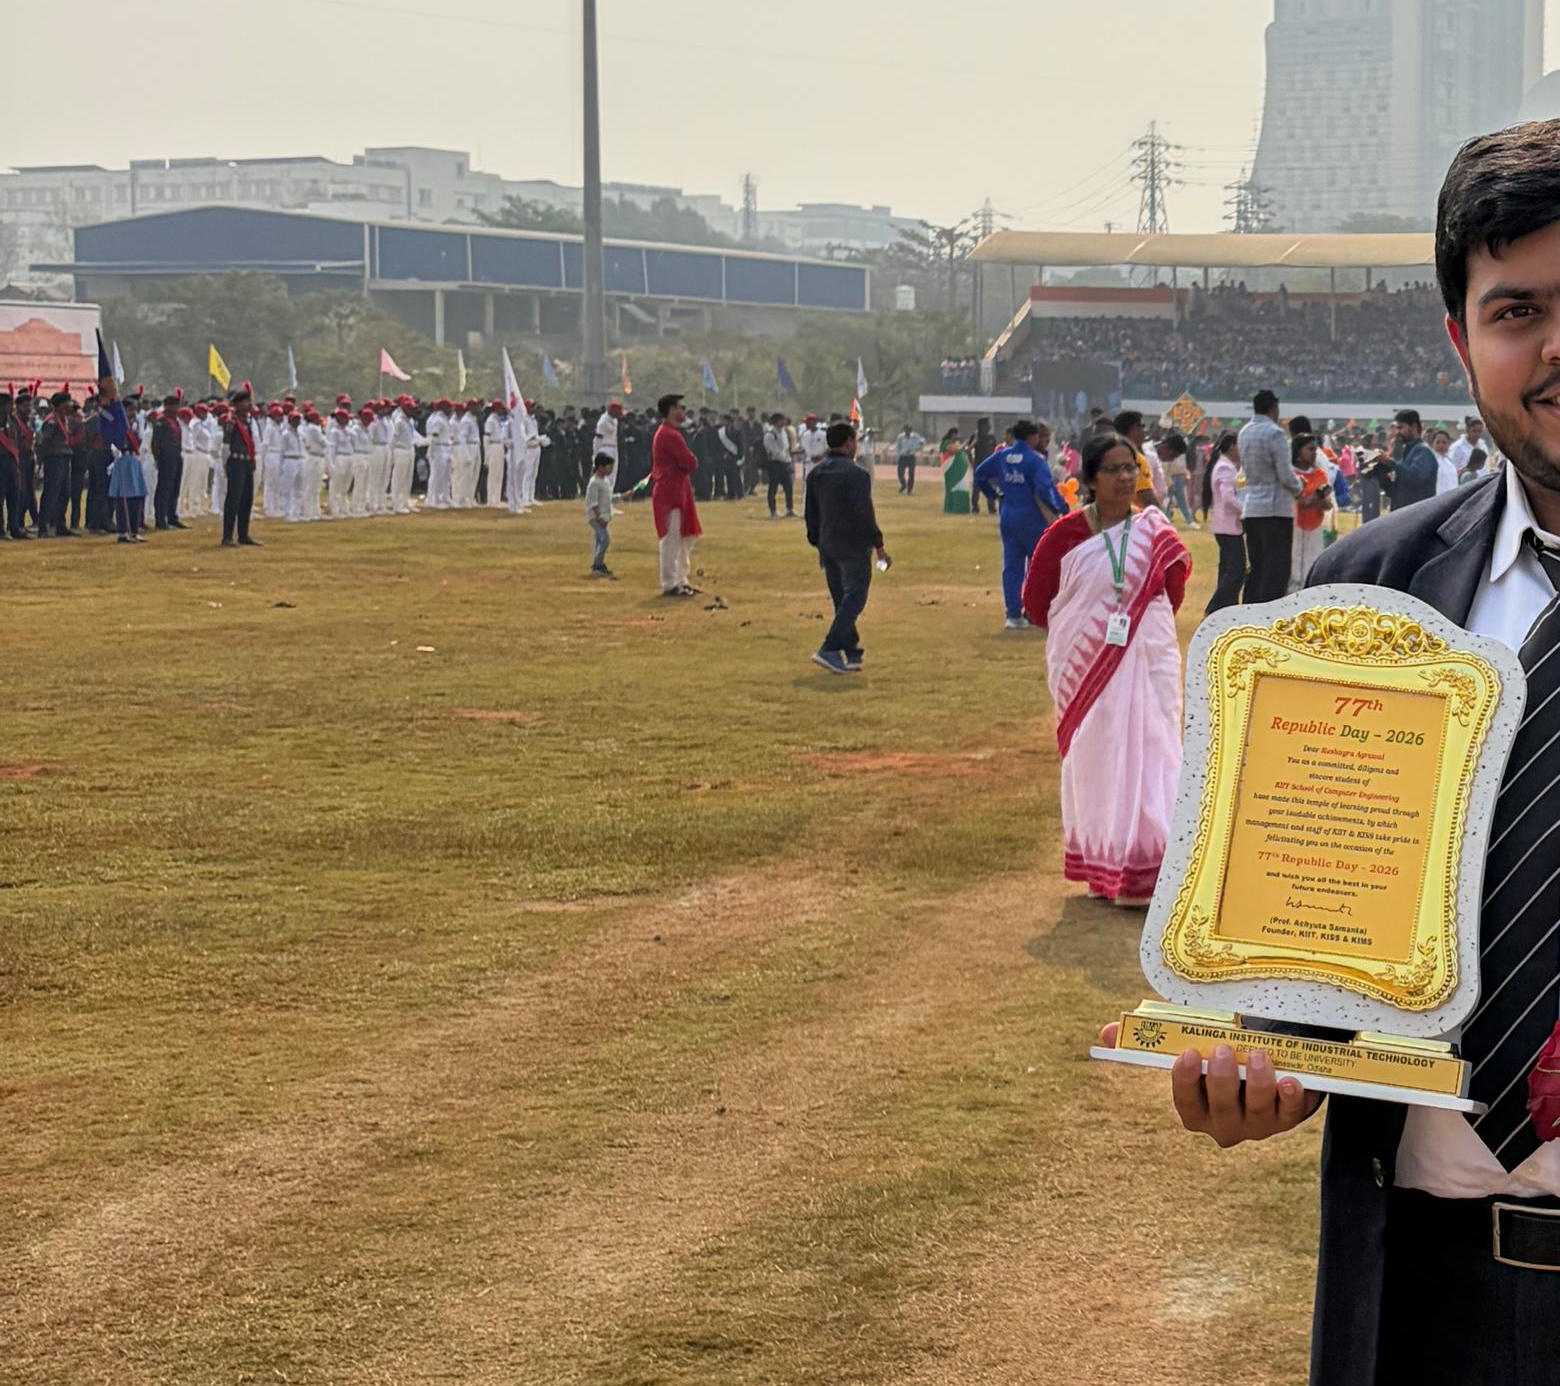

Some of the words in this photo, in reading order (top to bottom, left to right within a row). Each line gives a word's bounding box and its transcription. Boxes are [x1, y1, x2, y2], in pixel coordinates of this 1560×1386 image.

[1334, 696, 1383, 717] 77th
[1270, 716, 1336, 736] Republic
[1340, 724, 1370, 743] Day
[1385, 729, 1425, 746] 2026
[1303, 745, 1319, 753] Dear
[1308, 772, 1334, 781] sincere
[1335, 776, 1360, 784] student
[1362, 778, 1370, 787] of
[1274, 781, 1289, 790] KIIT
[1291, 783, 1314, 792] School
[1315, 786, 1323, 795] of
[1324, 786, 1357, 797] Computer
[1358, 790, 1400, 803] Engineering
[1253, 792, 1269, 800] have
[1306, 799, 1329, 808] temple
[1330, 801, 1340, 810] of
[1340, 802, 1368, 813] learning
[1392, 808, 1420, 819] through
[1286, 808, 1316, 818] laudable
[1367, 818, 1375, 828] by
[1377, 820, 1398, 828] which
[1245, 819, 1289, 829] management
[1306, 825, 1322, 835] staff
[1323, 827, 1331, 836] of
[1331, 827, 1347, 836] KIIT
[1357, 830, 1374, 839] KISS
[1375, 833, 1391, 841] take
[1392, 835, 1411, 843] pride
[1305, 840, 1318, 848] you
[1374, 847, 1383, 856] of
[1281, 853, 1332, 868] Republic
[1335, 860, 1358, 873] Day
[1369, 864, 1399, 876] 2026
[1291, 883, 1315, 892] future
[1343, 879, 1360, 887] best
[1370, 883, 1387, 891] your
[1261, 926, 1296, 938] Founder,
[1320, 932, 1340, 941] KISS
[1351, 936, 1373, 945] KIMS
[1294, 919, 1327, 930] Achyuta
[1328, 923, 1367, 934] Samanta)
[1181, 1024, 1227, 1040] KALINGA
[1229, 1031, 1284, 1047] INSTITUTE
[1285, 1039, 1299, 1049] OF
[1301, 1042, 1362, 1058] INDUSTRIAL
[1366, 1050, 1435, 1068] TECHNOLOGY
[1277, 1049, 1288, 1058] TO
[1290, 1052, 1302, 1061] BE
[1304, 1053, 1357, 1068] UNIVERSITY
[1307, 1063, 1333, 1074] Odisha
